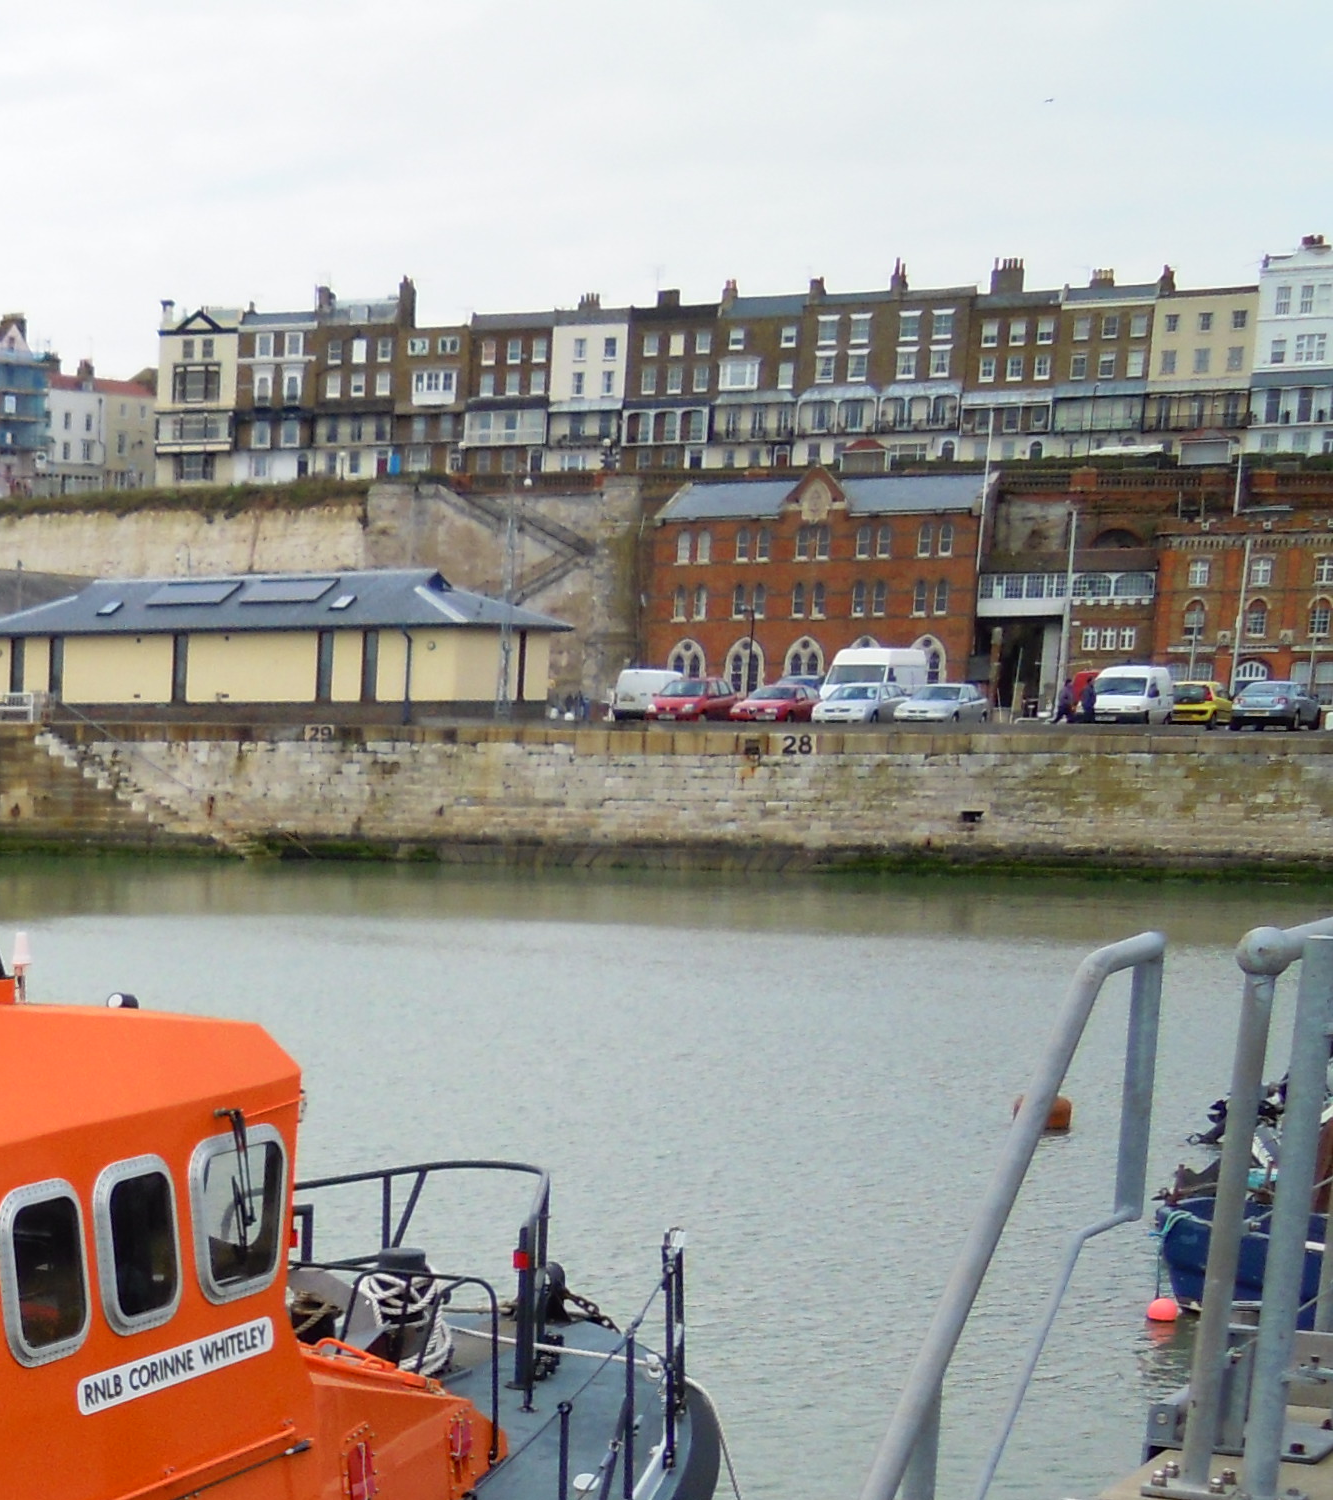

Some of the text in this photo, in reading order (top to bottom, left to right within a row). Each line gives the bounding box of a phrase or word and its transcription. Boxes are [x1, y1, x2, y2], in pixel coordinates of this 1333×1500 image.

[308, 725, 333, 742] 29
[781, 734, 813, 756] 28
[83, 1323, 267, 1408] RNLB CORINNE WHITELEY
